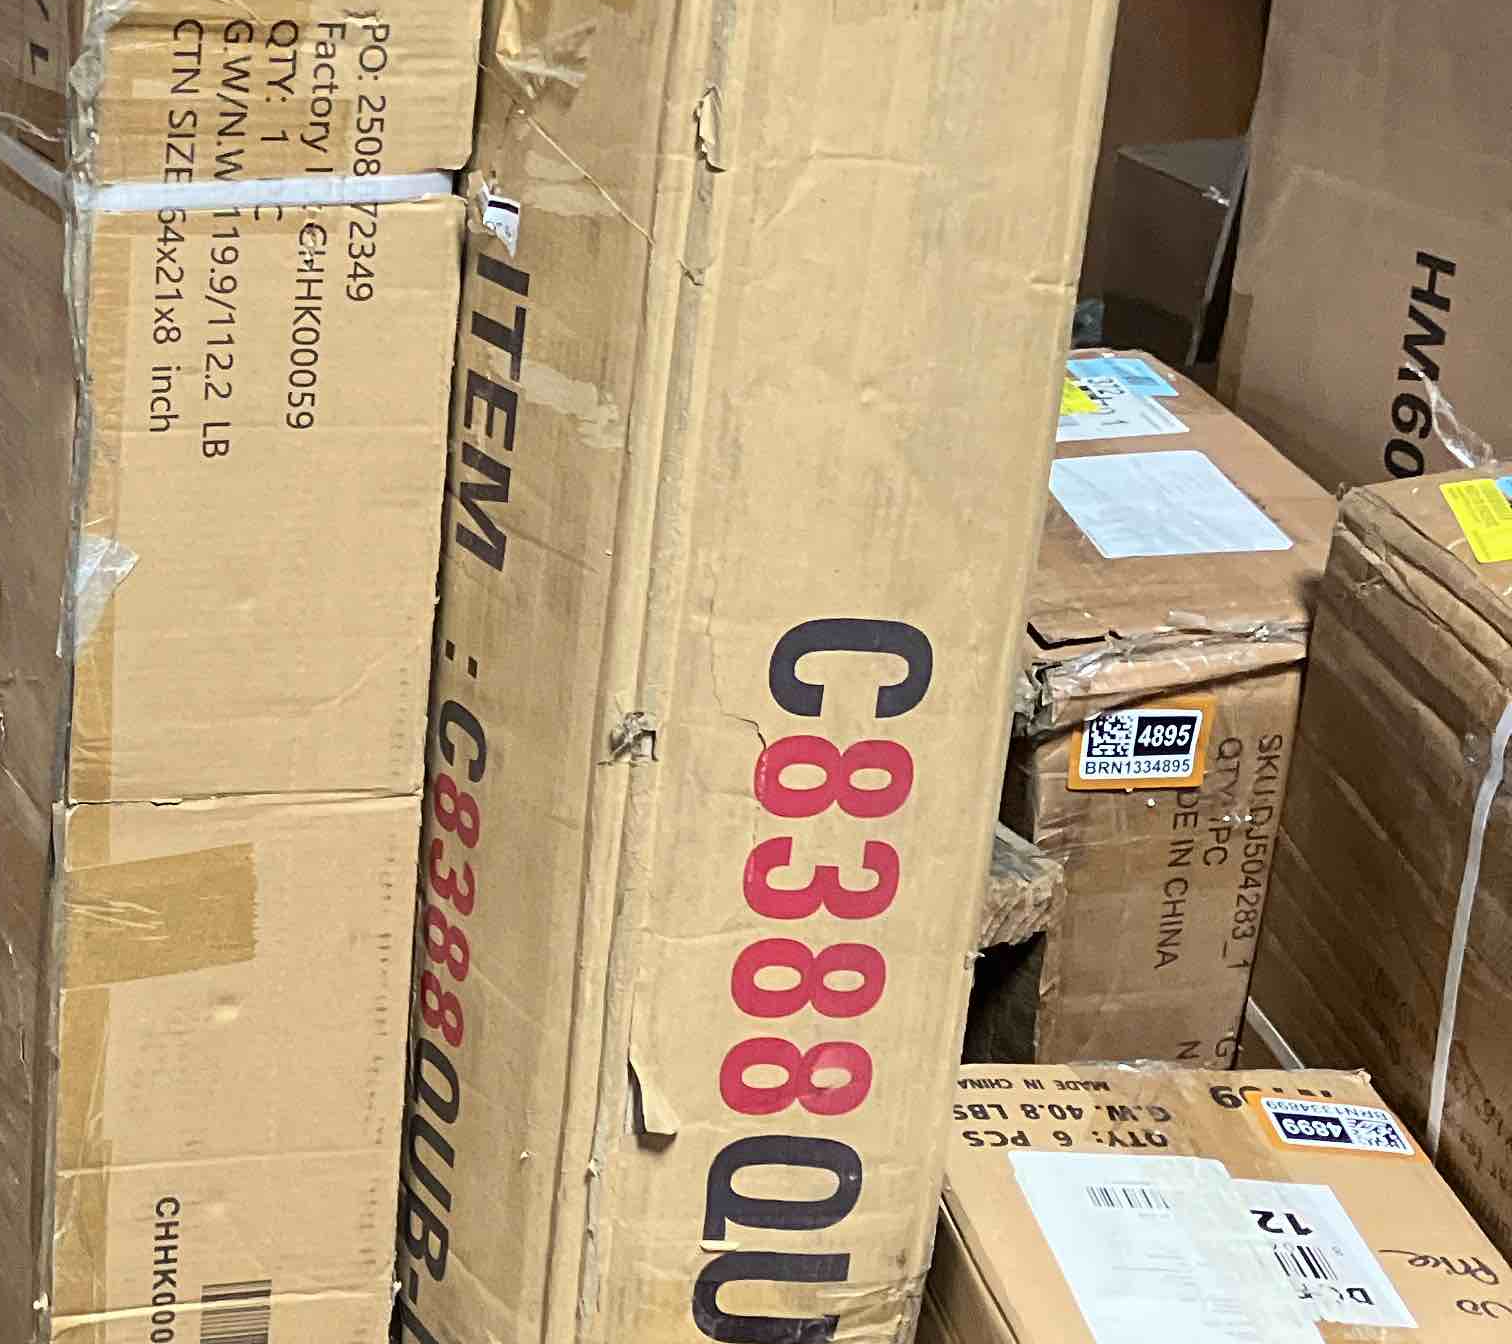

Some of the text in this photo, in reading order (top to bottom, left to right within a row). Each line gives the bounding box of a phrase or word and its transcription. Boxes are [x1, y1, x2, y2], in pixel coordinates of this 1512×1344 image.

[171, 18, 205, 100] CTN
[265, 18, 300, 104] QTY:
[299, 21, 347, 154] Factory
[259, 131, 288, 144] 1
[346, 22, 391, 303] PO: 250872349
[203, 208, 241, 402] 119.9/112.2
[1382, 249, 1458, 479] HM60
[149, 366, 181, 434] inch
[455, 254, 531, 574] ITEM
[200, 418, 231, 460] LB
[1137, 723, 1193, 749] 4895
[1083, 757, 1192, 776] BRN1334895
[1169, 838, 1194, 868] IN
[1153, 876, 1189, 970] CHINA
[1023, 1078, 1047, 1092] IN
[1054, 1078, 1111, 1093] MADE
[952, 1103, 1006, 1122] LBS
[1013, 1102, 1085, 1123] 40.8
[1279, 1116, 1344, 1139] 4899
[961, 1128, 1169, 1150] QTY: 6 PCS
[1249, 1208, 1313, 1238] 12
